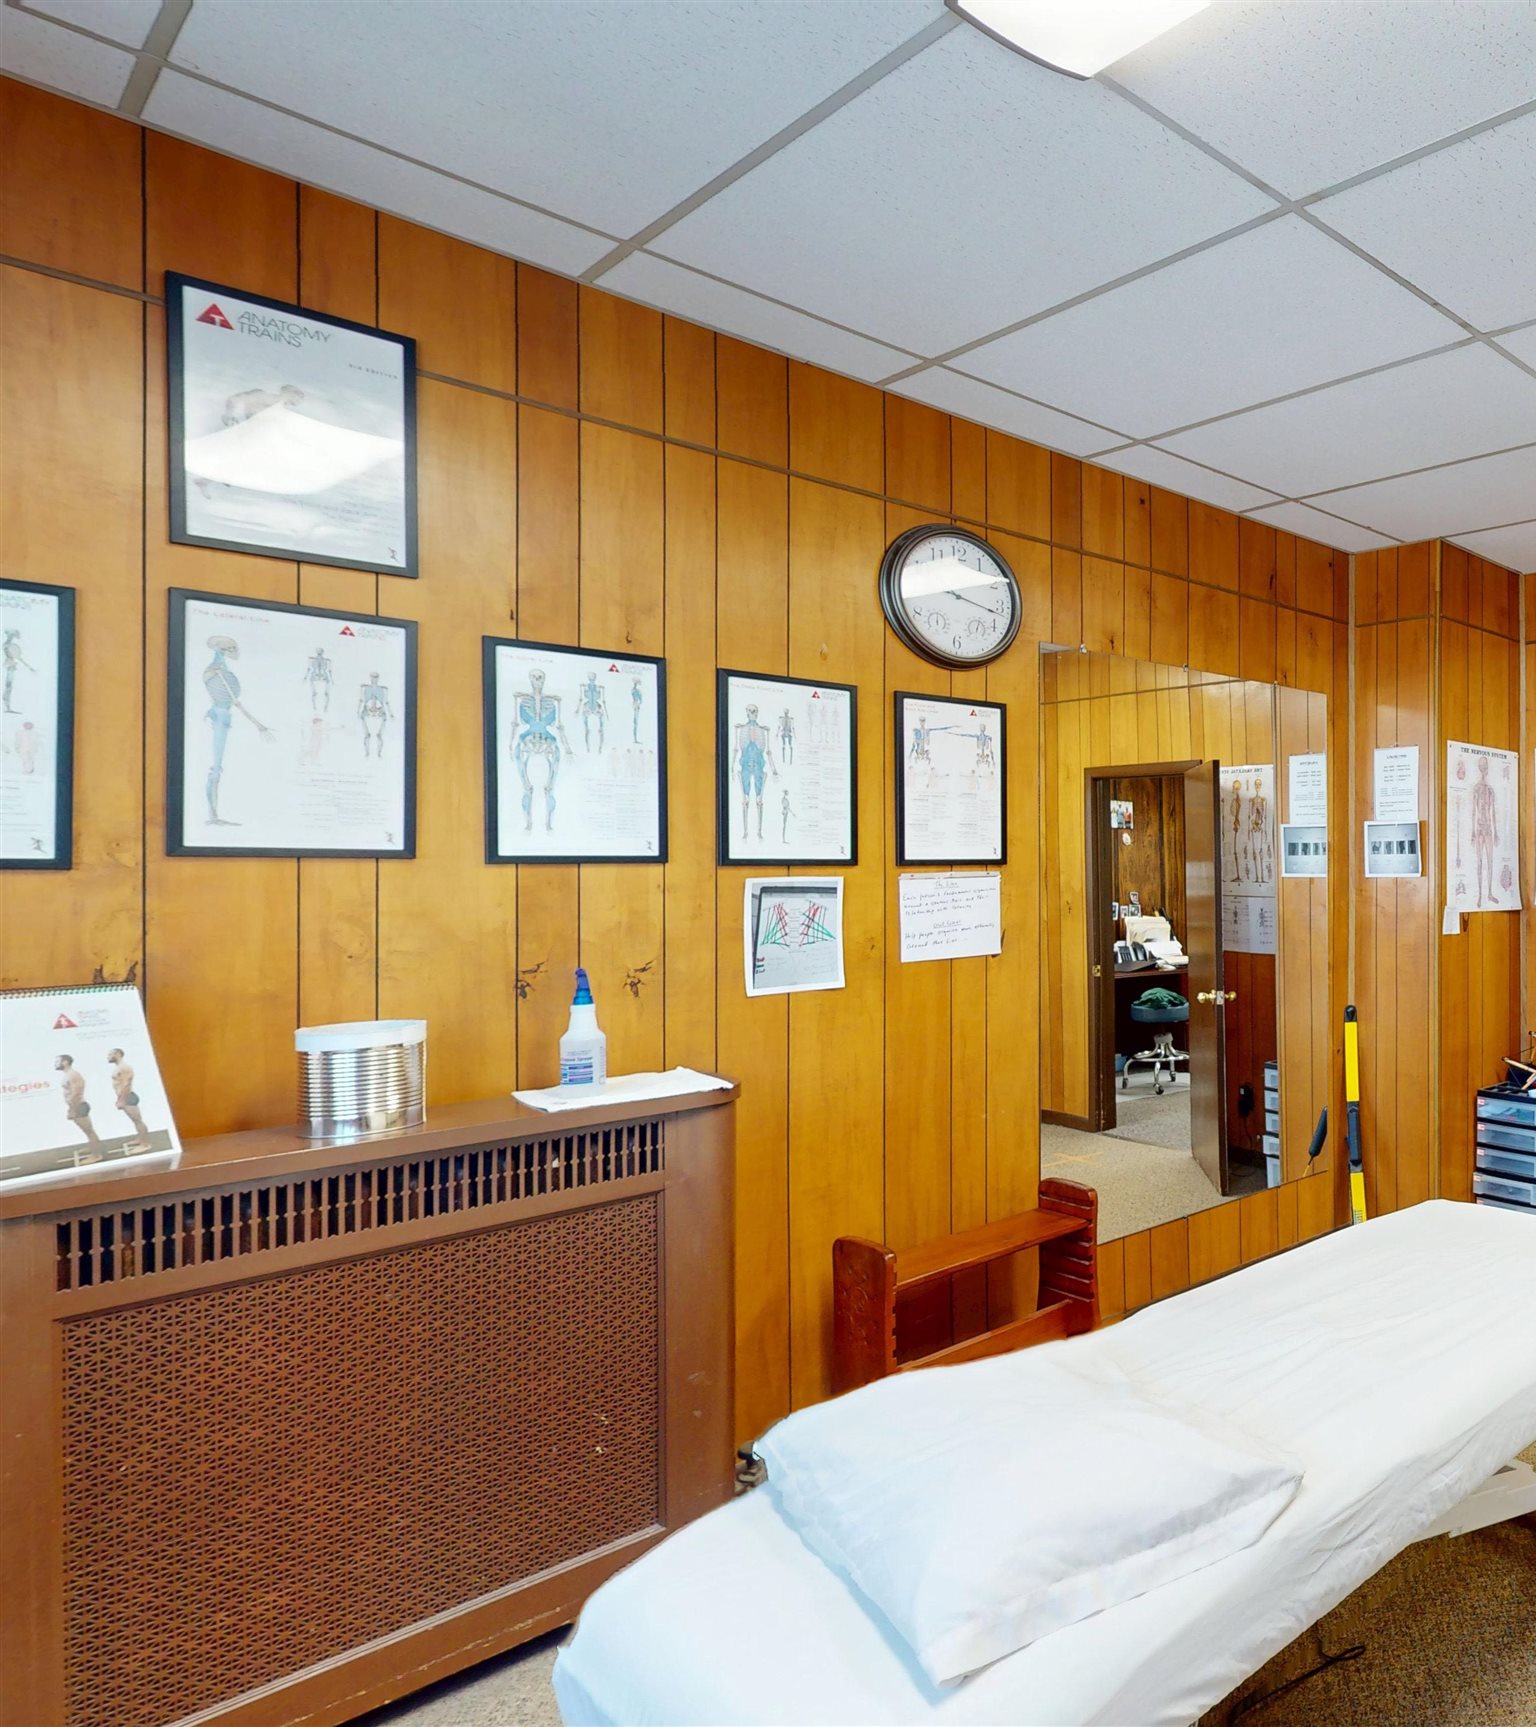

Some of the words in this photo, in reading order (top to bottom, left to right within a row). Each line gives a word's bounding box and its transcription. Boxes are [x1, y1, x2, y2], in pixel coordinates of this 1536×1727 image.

[237, 310, 331, 343] ANATOMY
[239, 321, 302, 348] TRAINS
[931, 547, 943, 561] 11
[952, 545, 967, 562] 12
[953, 635, 962, 650] 6
[1470, 748, 1491, 758] NERVOUS
